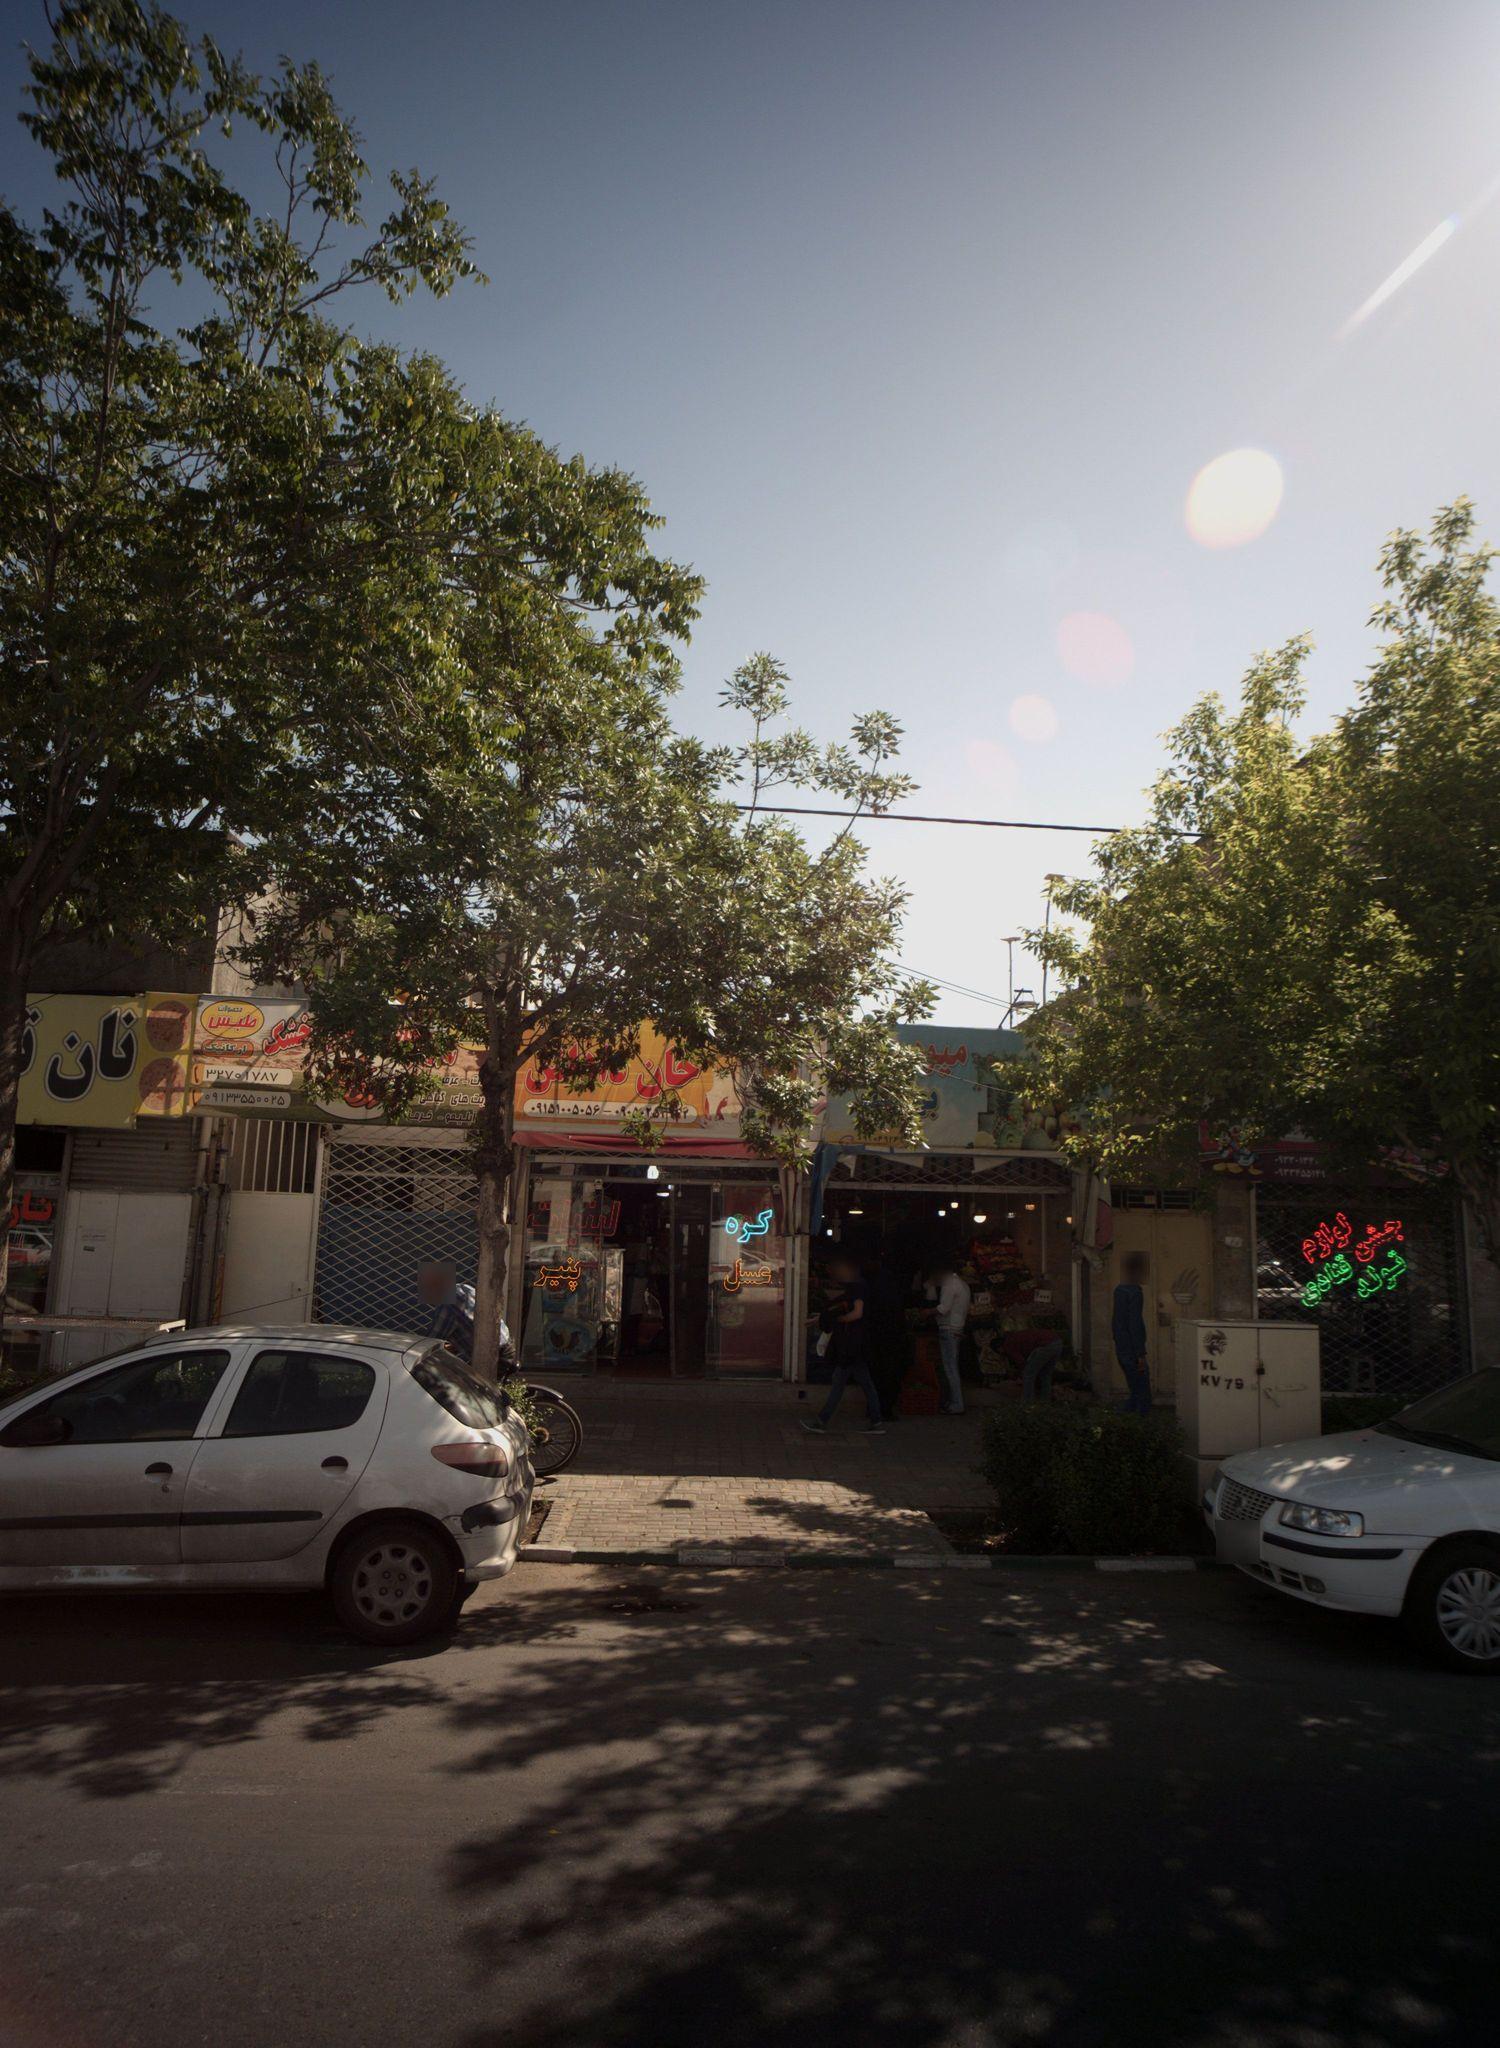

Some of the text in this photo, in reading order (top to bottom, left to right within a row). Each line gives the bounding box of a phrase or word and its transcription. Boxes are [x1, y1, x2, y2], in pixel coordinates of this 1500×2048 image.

[208, 1014, 258, 1032] طبس
[46, 1008, 137, 1101] نان
[725, 1208, 774, 1244] کره
[1301, 1210, 1352, 1265] لوازم
[1354, 1219, 1405, 1263] جشن
[533, 1256, 581, 1293] پنیر
[723, 1257, 773, 1292] عسل
[1300, 1253, 1353, 1309] قنادی
[1356, 1248, 1408, 1299] تولد
[1200, 1359, 1218, 1371] TL
